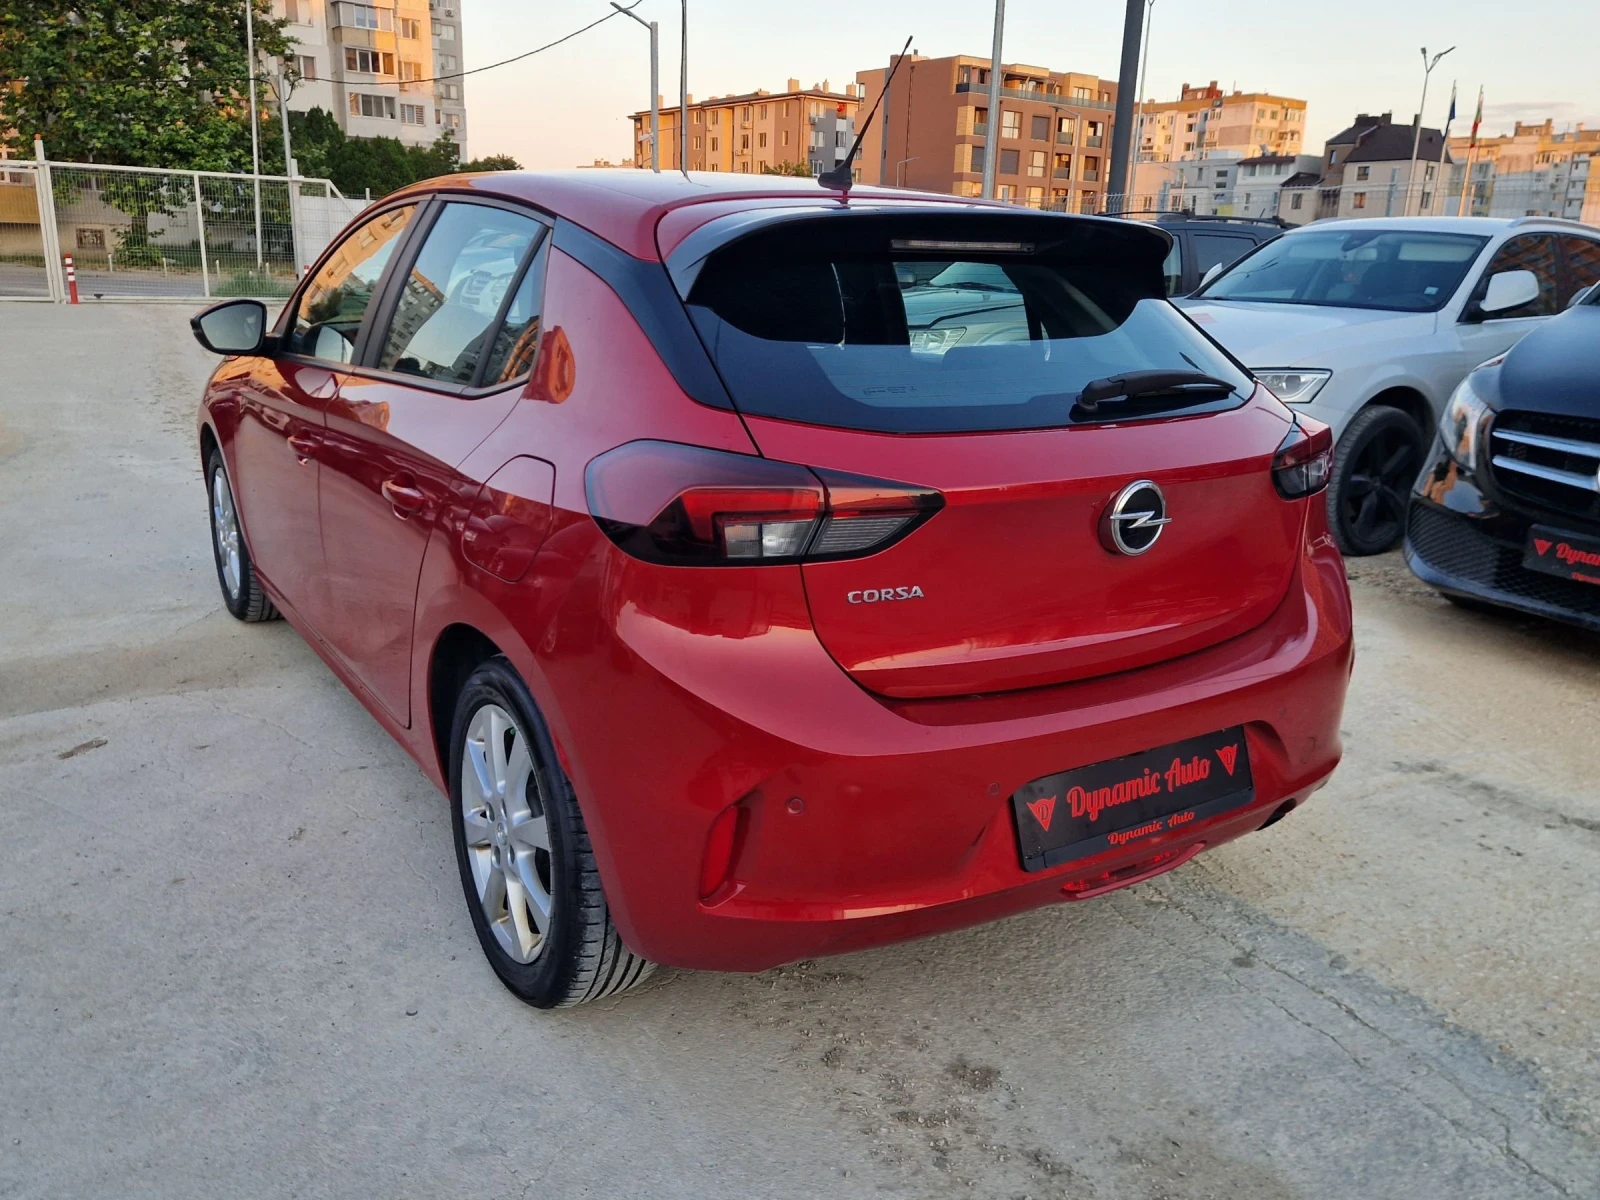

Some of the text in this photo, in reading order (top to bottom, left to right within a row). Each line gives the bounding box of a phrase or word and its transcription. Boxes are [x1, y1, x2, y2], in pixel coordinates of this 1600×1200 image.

[847, 585, 924, 604] CORSA
[1066, 755, 1211, 822] Dynamic Auto
[1107, 811, 1196, 845] Dynamic Auto
